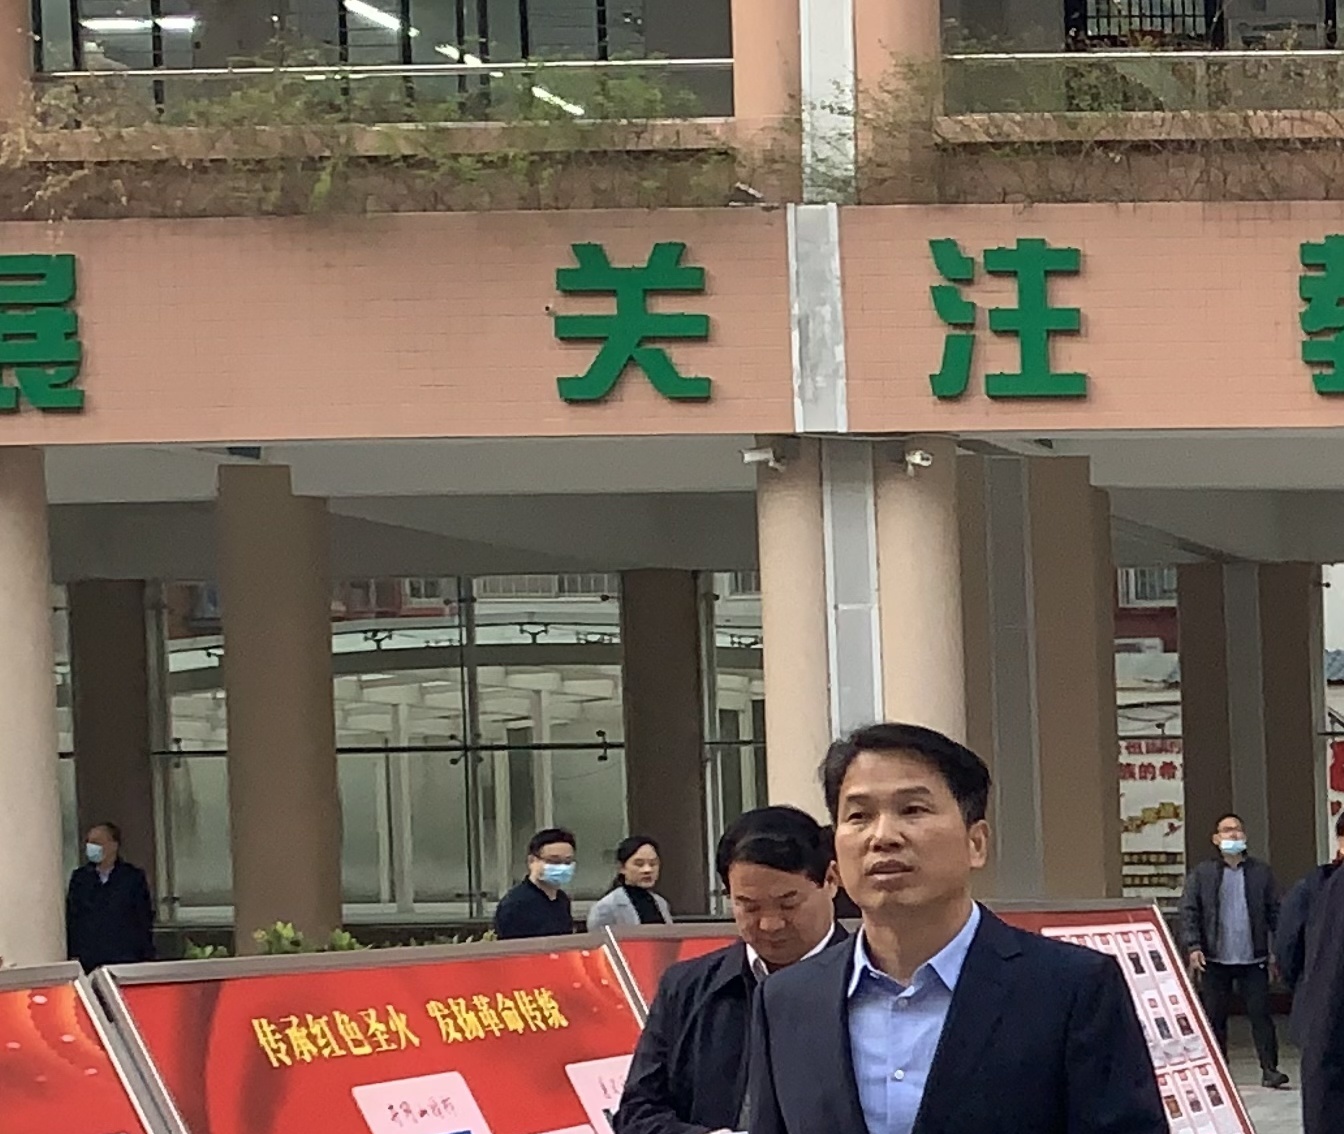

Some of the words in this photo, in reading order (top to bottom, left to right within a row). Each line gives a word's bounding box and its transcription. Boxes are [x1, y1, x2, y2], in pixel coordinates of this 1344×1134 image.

[251, 1004, 420, 1068] 传承红色圣火
[426, 987, 569, 1044] 发扬革命传统
